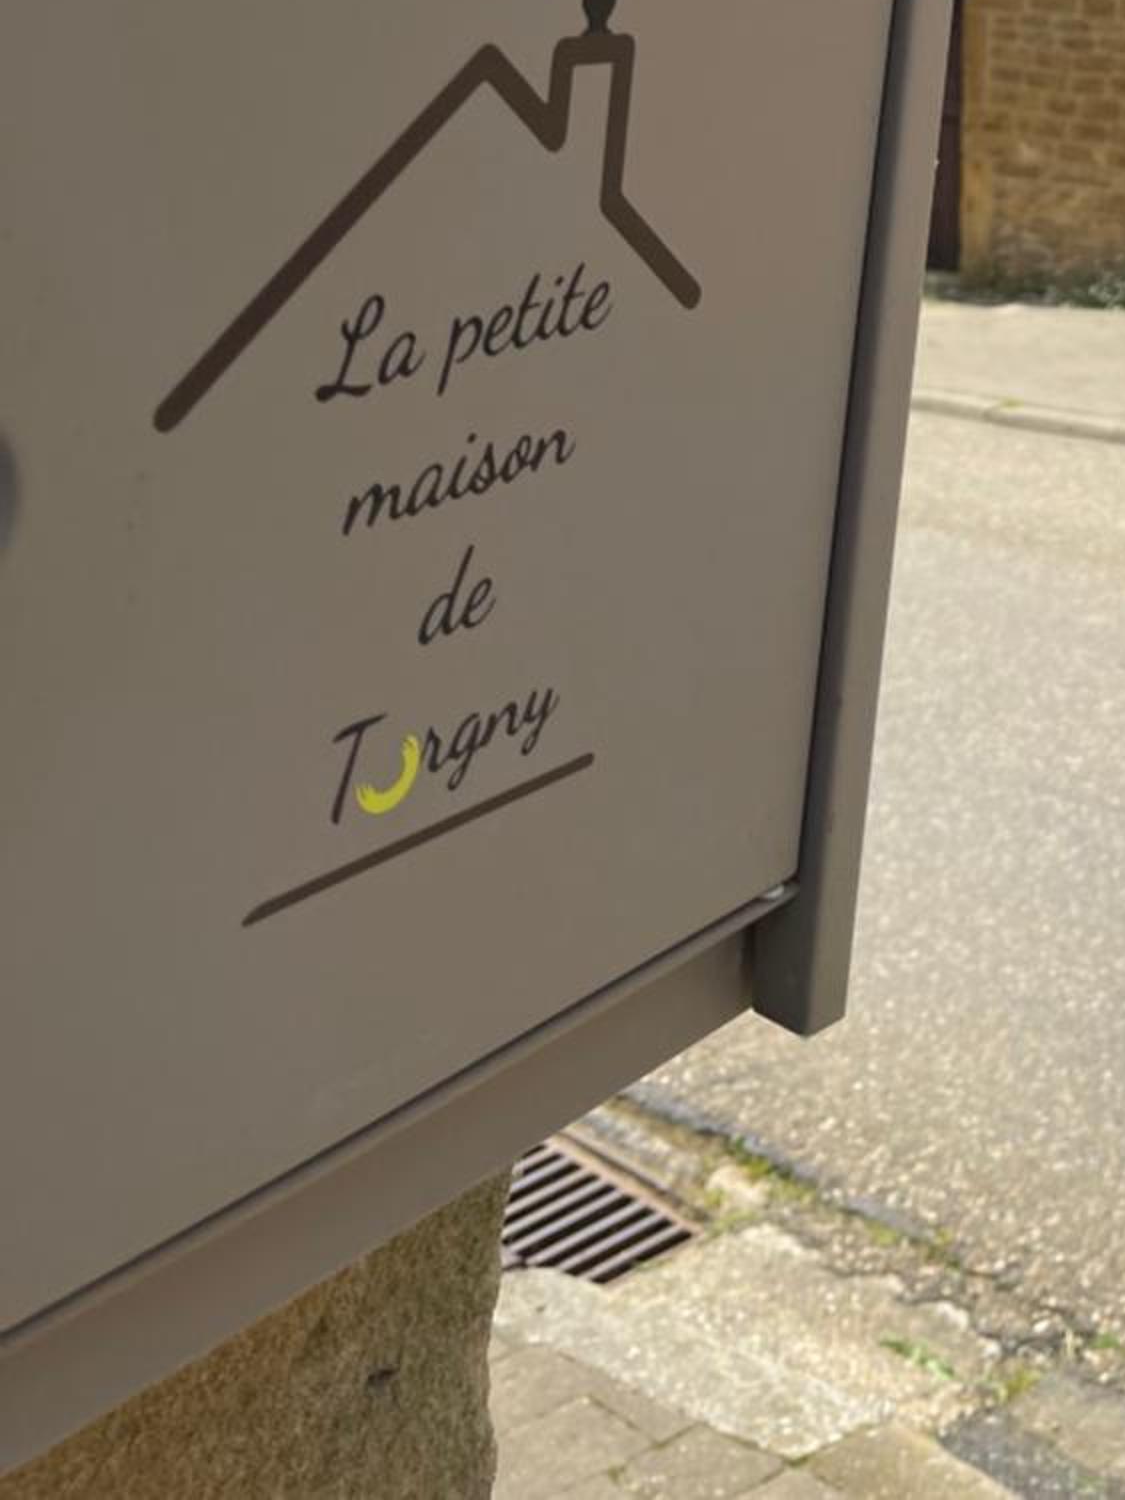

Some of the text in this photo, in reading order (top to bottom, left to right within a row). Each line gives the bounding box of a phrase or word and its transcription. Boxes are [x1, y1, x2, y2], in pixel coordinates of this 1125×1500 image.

[315, 262, 613, 403] La petite
[341, 429, 577, 536] maison
[417, 544, 497, 646] de
